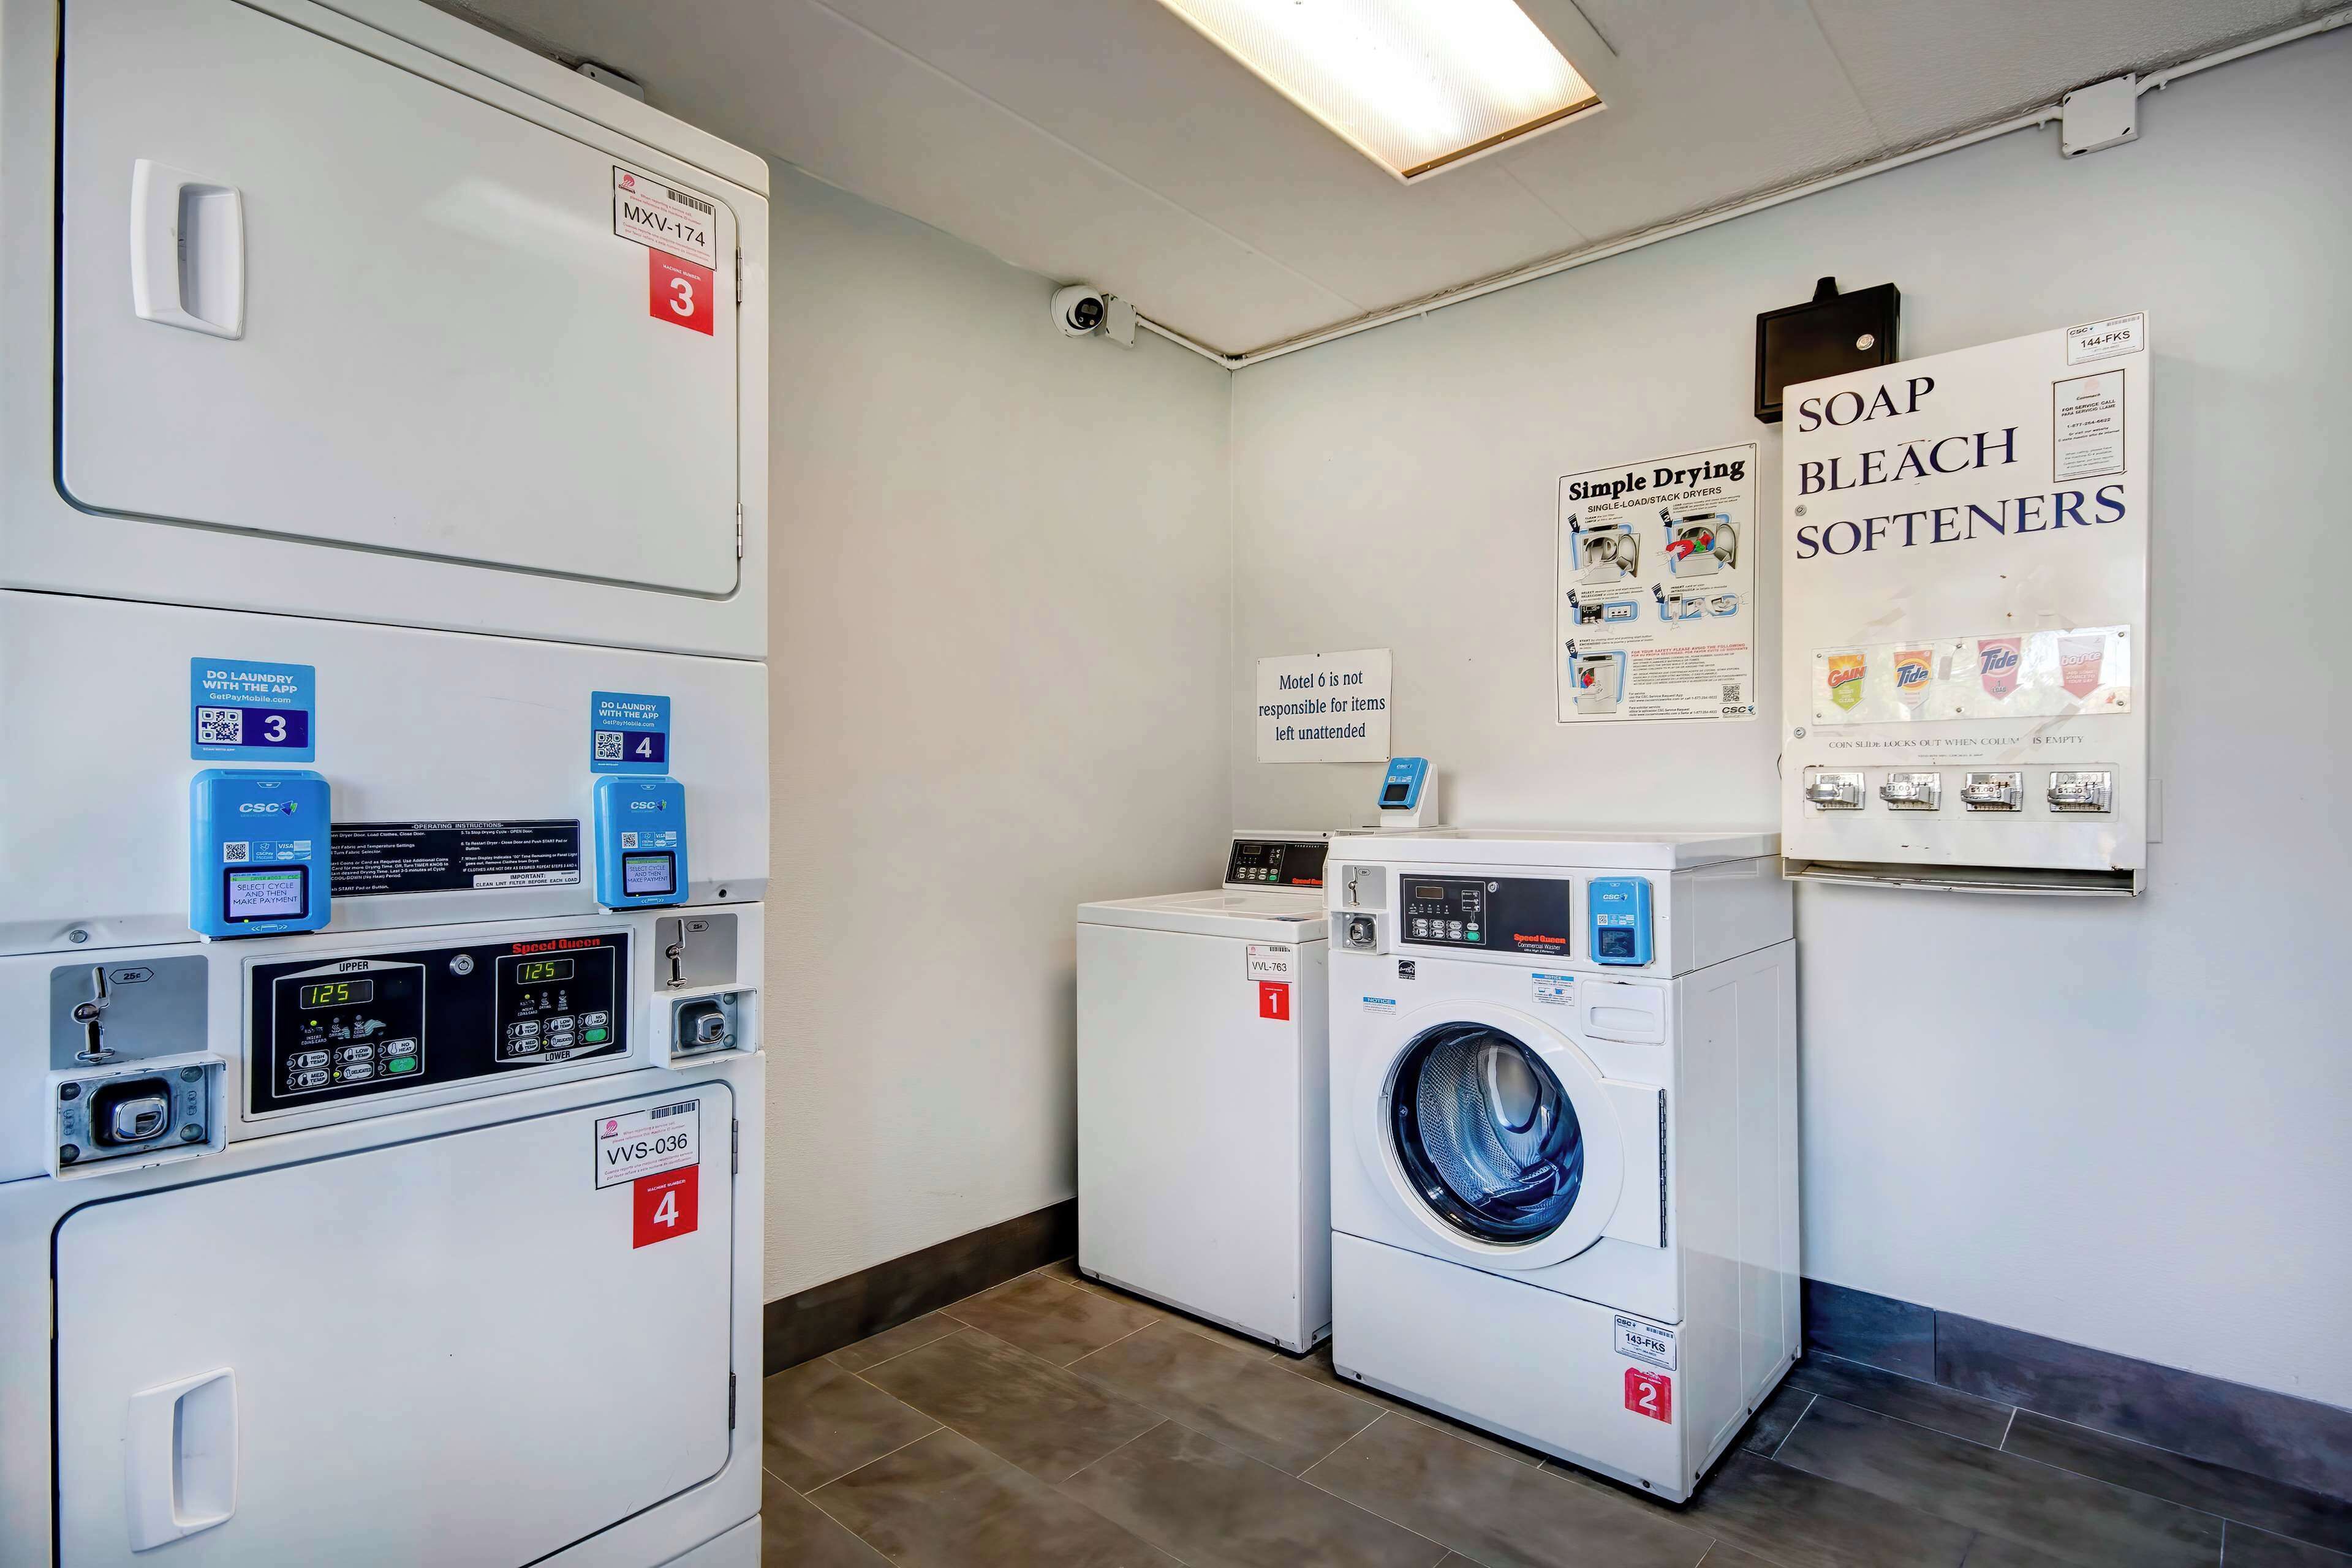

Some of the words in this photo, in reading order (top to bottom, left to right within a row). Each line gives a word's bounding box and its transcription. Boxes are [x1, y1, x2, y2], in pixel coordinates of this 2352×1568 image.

[624, 202, 705, 246] MXV-174
[670, 277, 694, 317] 3
[2081, 331, 2130, 347] 144-FKS
[1799, 377, 1935, 432] SOAP
[1798, 427, 2019, 496] BLEACH
[1569, 472, 1646, 501] Simple
[1653, 461, 1745, 488] Drying
[1588, 494, 1680, 513] SINGLE-LOAD/STACK
[1683, 486, 1722, 499] DRYERS
[1796, 484, 2125, 559] SOFTENERS
[1980, 648, 2019, 674] Tide
[206, 671, 227, 679] DO
[231, 672, 293, 684] LAUNDRY
[1280, 673, 1314, 690] Motel
[1318, 672, 1325, 687] 6
[1330, 671, 1339, 686] is
[1344, 670, 1363, 685] not
[1828, 666, 1867, 687] GAIN
[1896, 664, 1929, 687] Tide
[202, 680, 239, 690] WITH
[243, 683, 269, 692] THE
[210, 693, 291, 703] GetPayMobile.com
[1259, 699, 1326, 719] responsible
[1331, 698, 1347, 712] for
[1352, 696, 1385, 711] items
[264, 715, 287, 742] 3
[1276, 726, 1295, 741] left
[1299, 723, 1366, 740] unattended
[636, 737, 652, 758] 4
[239, 803, 279, 813] CSC
[512, 941, 556, 955] Speed
[559, 938, 600, 949] Queen
[1514, 933, 1539, 942] Speed
[1540, 935, 1566, 944] Queen
[339, 961, 368, 972] UPPER
[526, 962, 554, 980] 125
[1252, 962, 1287, 971] VVL-763
[312, 984, 348, 1004] 125
[1269, 993, 1277, 1013] 1
[545, 1050, 570, 1061] LOWER
[607, 1133, 687, 1164] VVS-036
[654, 1191, 679, 1227] 4
[1626, 1333, 1665, 1352] 143-FKS
[1639, 1382, 1657, 1411] 2
